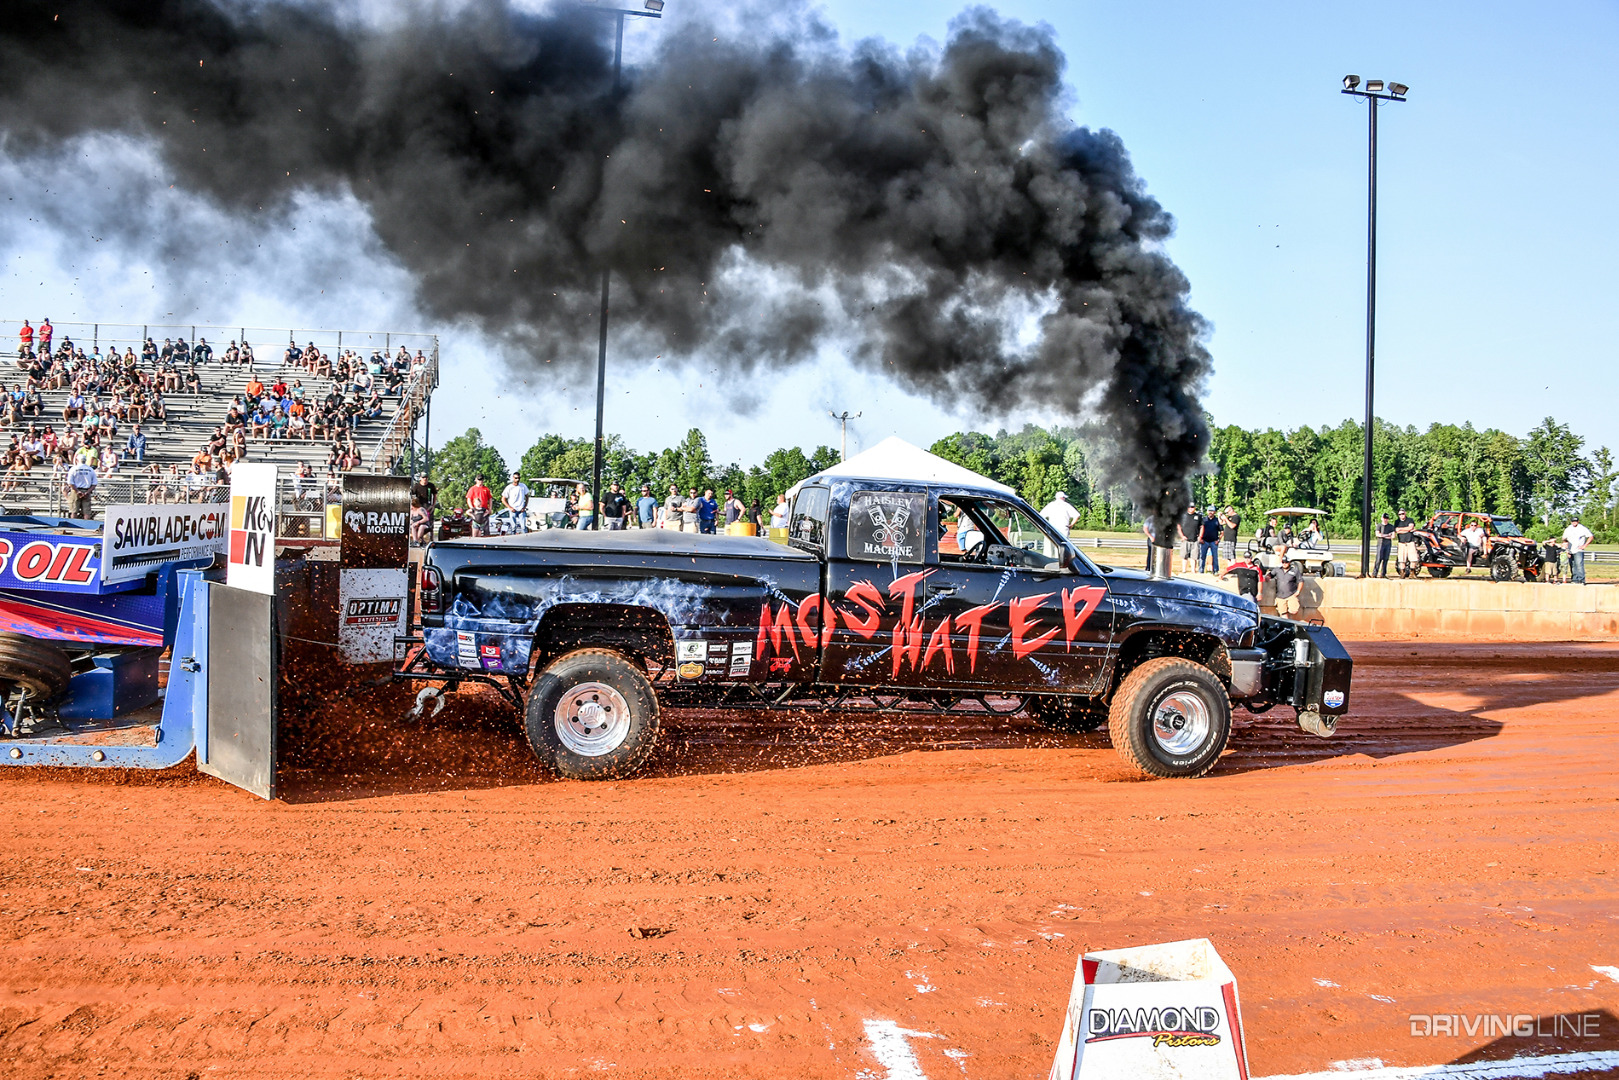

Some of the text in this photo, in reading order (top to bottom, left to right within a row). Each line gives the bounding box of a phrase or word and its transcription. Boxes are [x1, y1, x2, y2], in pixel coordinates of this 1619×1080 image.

[865, 496, 913, 509] HAISLEY
[366, 512, 405, 525] RAM
[366, 525, 405, 534] MOUNTS
[864, 542, 913, 557] MACHINE
[14, 542, 96, 584] OIL
[349, 600, 398, 615] OPTIMA
[756, 567, 938, 664] MOST
[892, 585, 1107, 680] HATED
[1088, 1006, 1220, 1033] DIAMOND
[1152, 1032, 1220, 1047] Pistons
